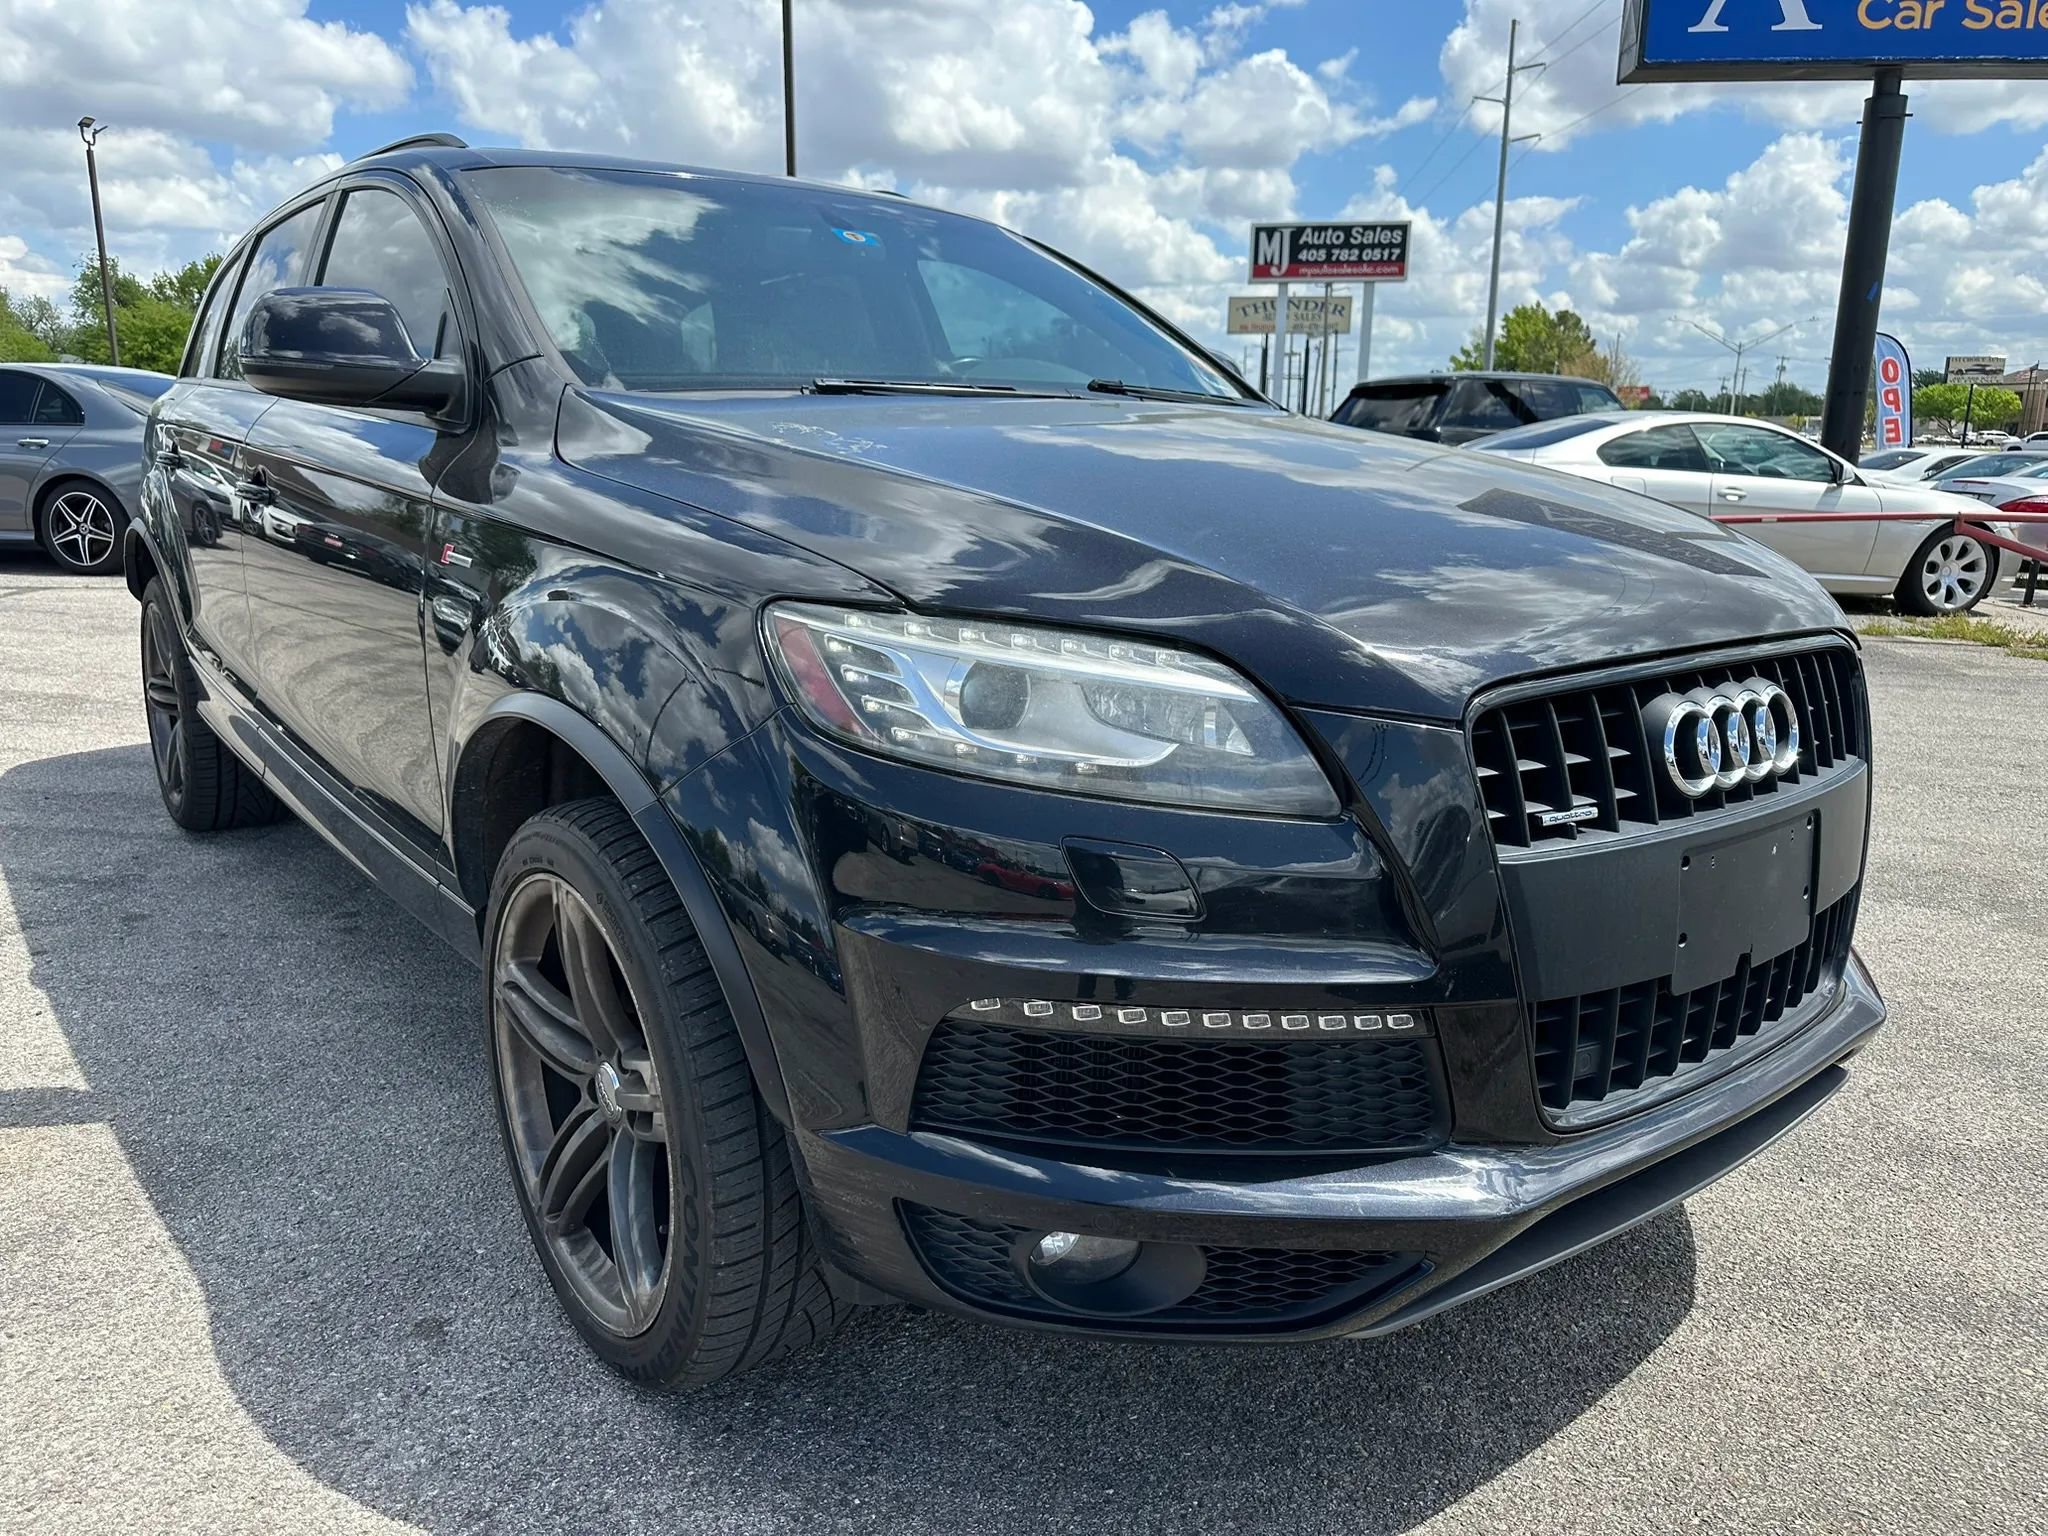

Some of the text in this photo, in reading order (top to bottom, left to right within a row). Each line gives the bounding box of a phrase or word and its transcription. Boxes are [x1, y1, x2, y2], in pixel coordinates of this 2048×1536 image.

[1857, 0, 1944, 30] Car
[1299, 226, 1403, 245] Auto Sales
[1257, 228, 1296, 276] MJ
[1298, 247, 1401, 262] 405 782 0517
[1550, 810, 1593, 822] quattro
